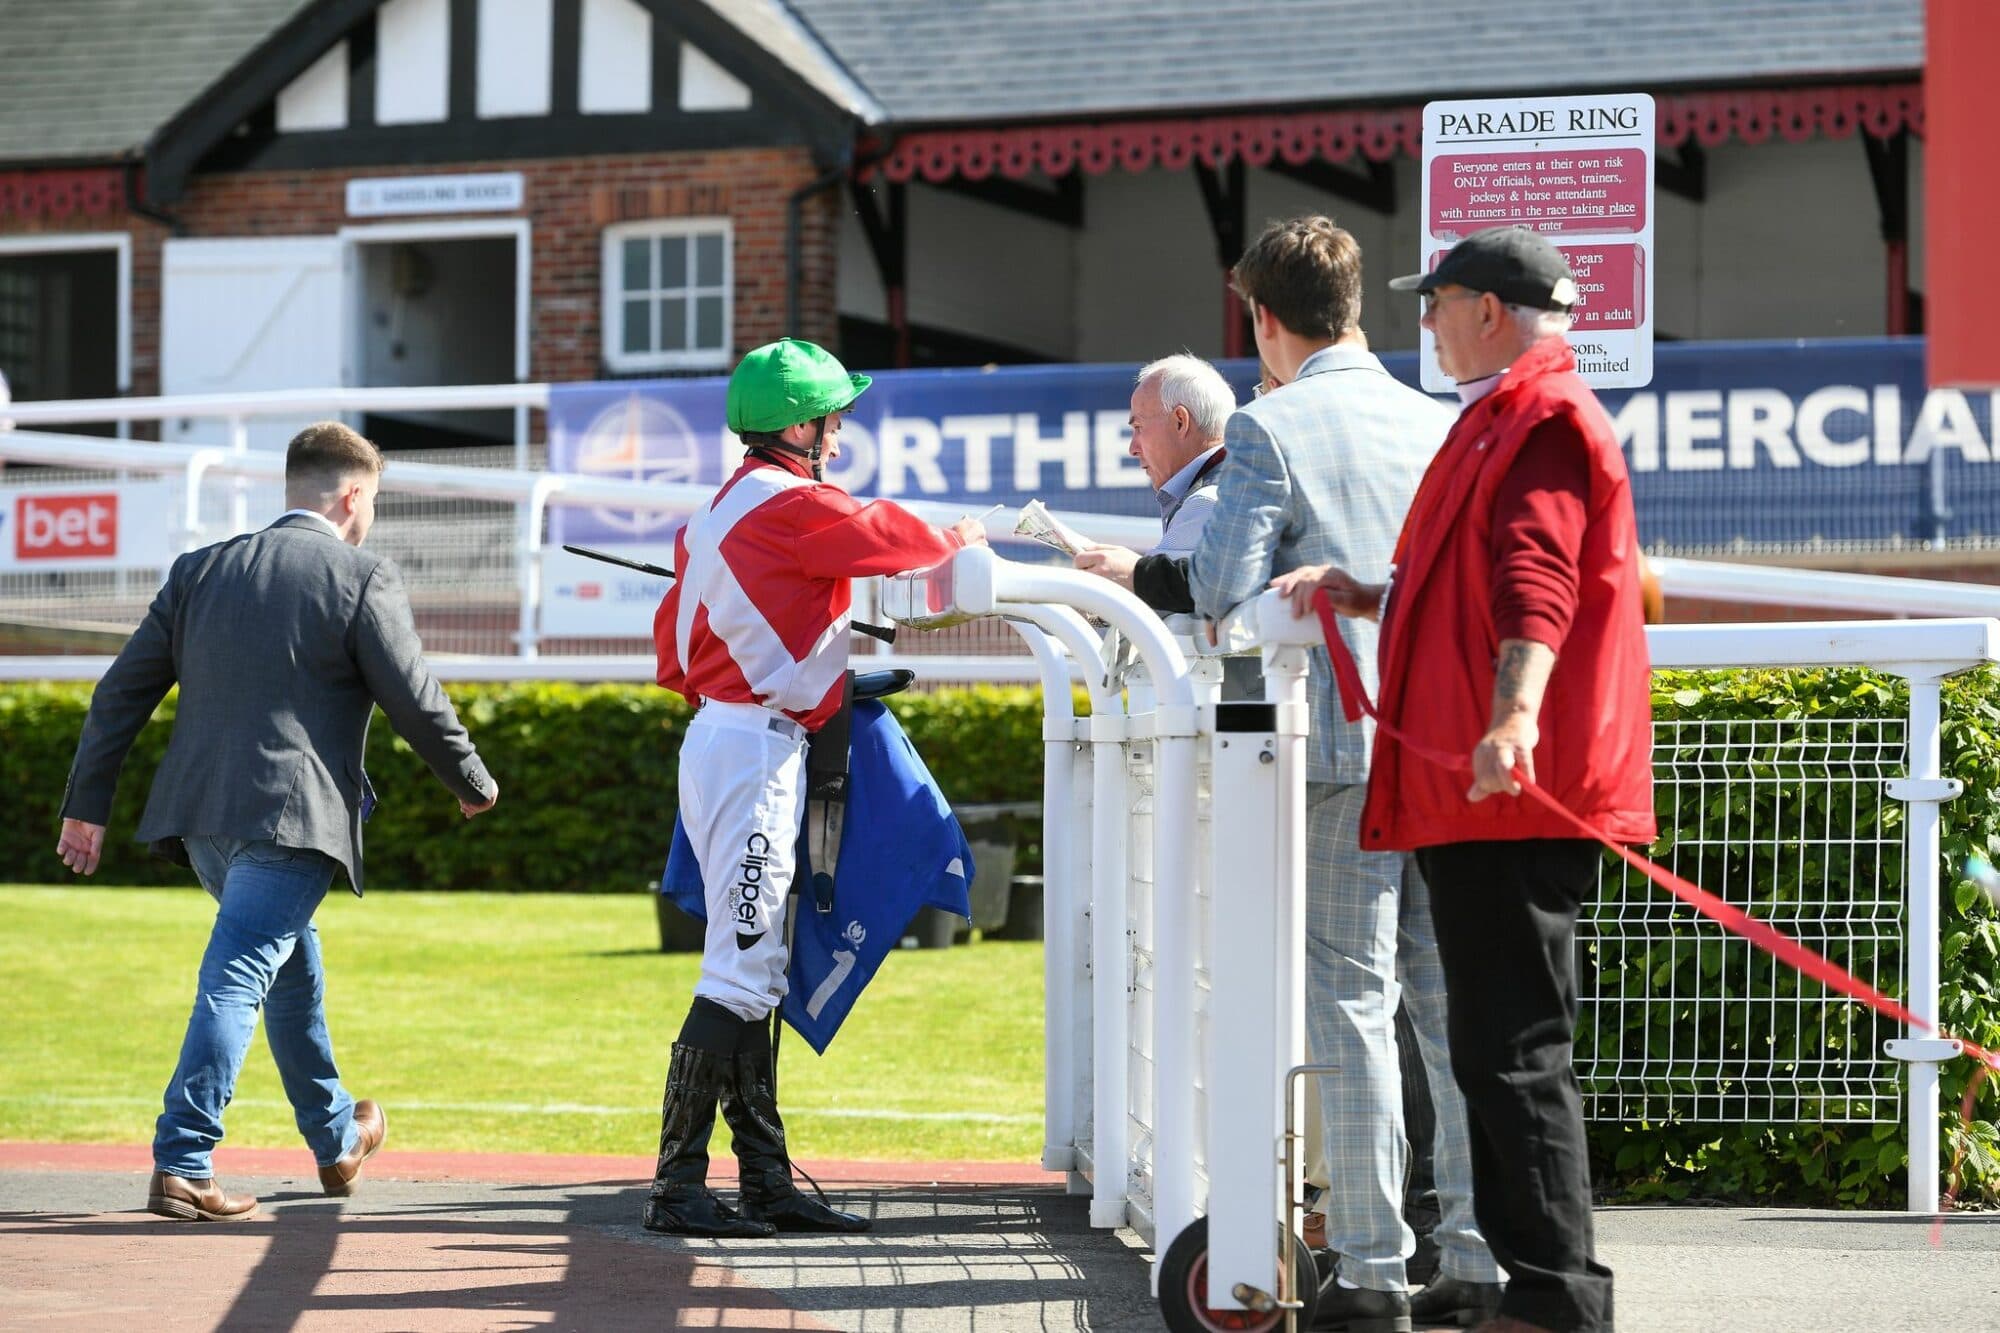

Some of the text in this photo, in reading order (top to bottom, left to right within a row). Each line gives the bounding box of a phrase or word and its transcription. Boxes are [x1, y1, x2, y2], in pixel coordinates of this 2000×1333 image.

[1440, 106, 1639, 136] PARADE RING
[1453, 157, 1623, 174] Everyone enters at their own risk
[1454, 172, 1622, 188] ONLY officials, owners, trainers,
[1469, 188, 1607, 204] jockeys & horse attendants
[1440, 202, 1635, 218] with runners in the race taking place
[1538, 222, 1563, 231] enter
[1576, 254, 1604, 266] years
[1585, 312, 1599, 320] an
[1604, 308, 1632, 320] adult
[1577, 357, 1629, 373] limited
[24, 500, 109, 548] bet
[738, 832, 769, 929] Clipper
[806, 950, 856, 1021] 1
